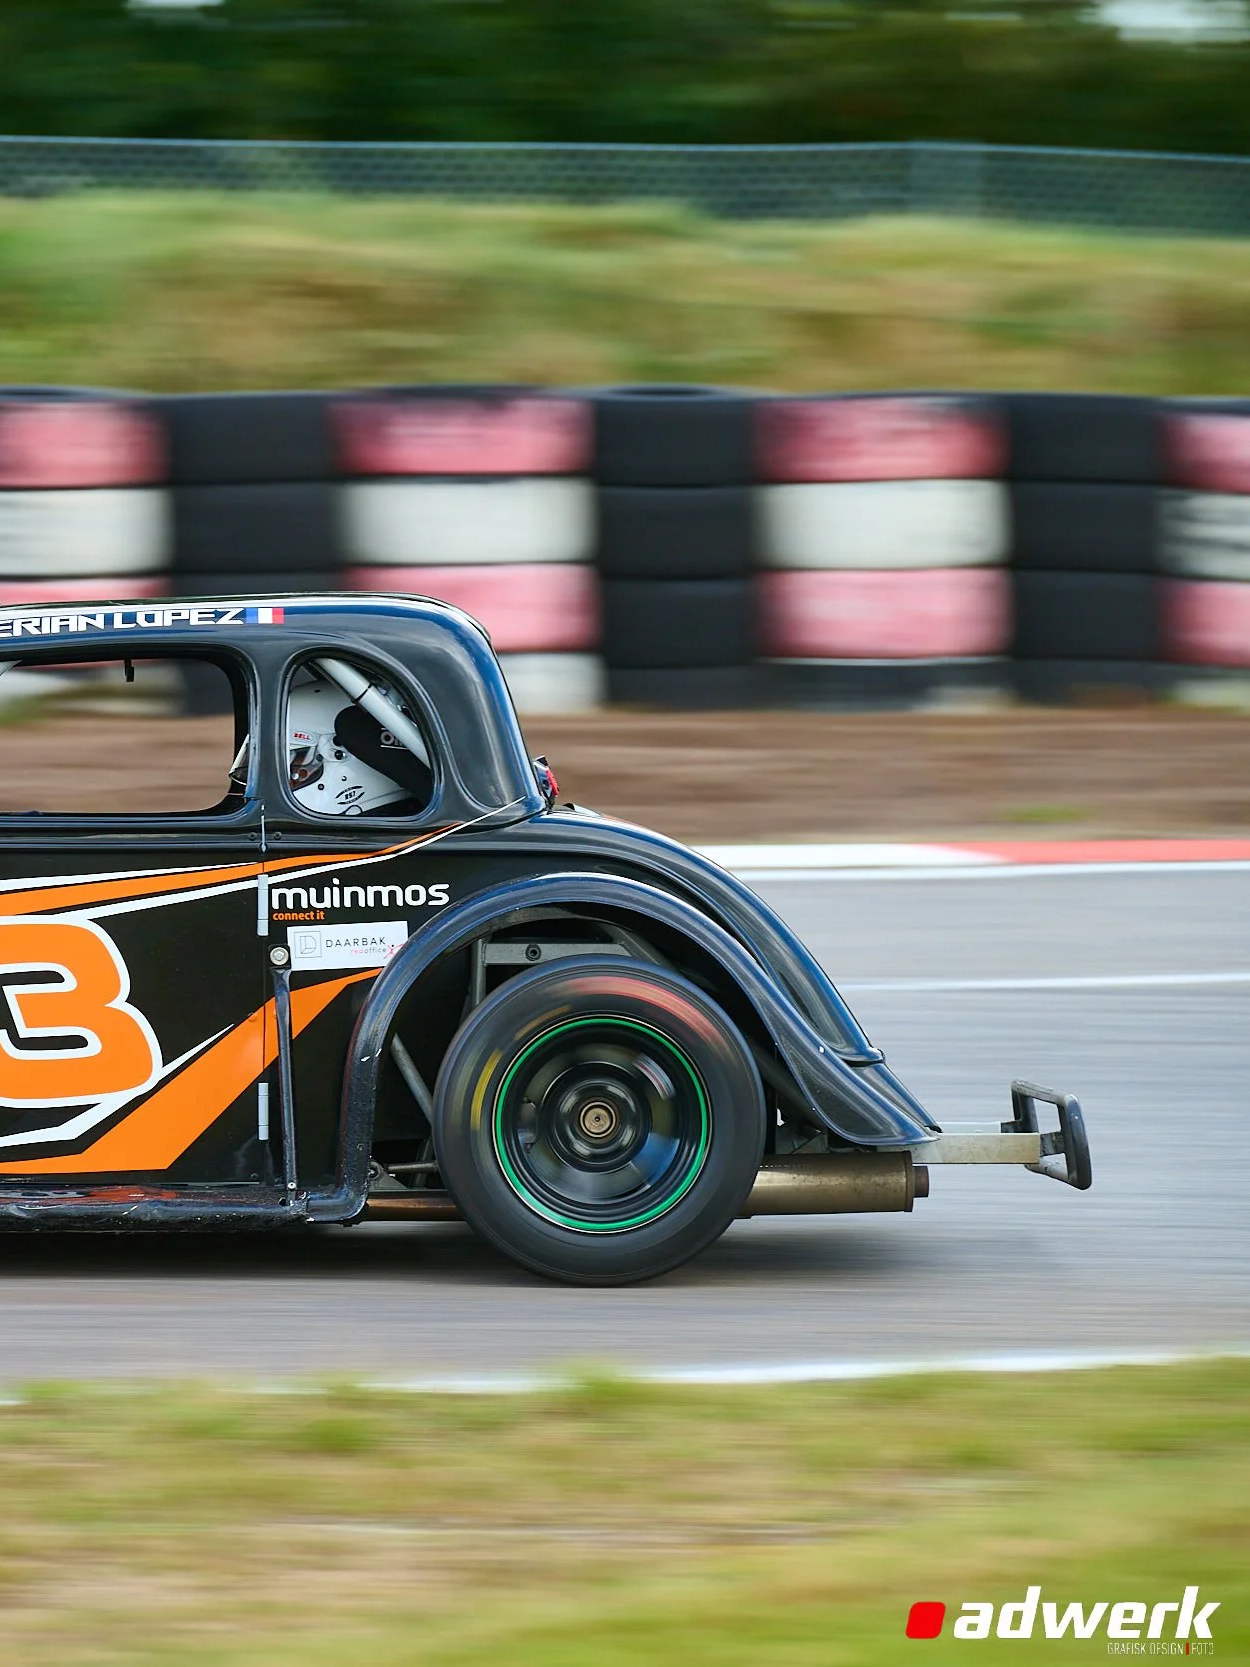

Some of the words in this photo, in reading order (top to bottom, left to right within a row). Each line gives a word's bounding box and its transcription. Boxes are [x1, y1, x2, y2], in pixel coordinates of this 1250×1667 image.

[113, 607, 244, 629] LOPEZ
[293, 732, 311, 741] BELL
[271, 877, 450, 910] muinmos
[272, 911, 315, 921] connect
[316, 910, 326, 920] it
[325, 937, 386, 948] DAARBAK
